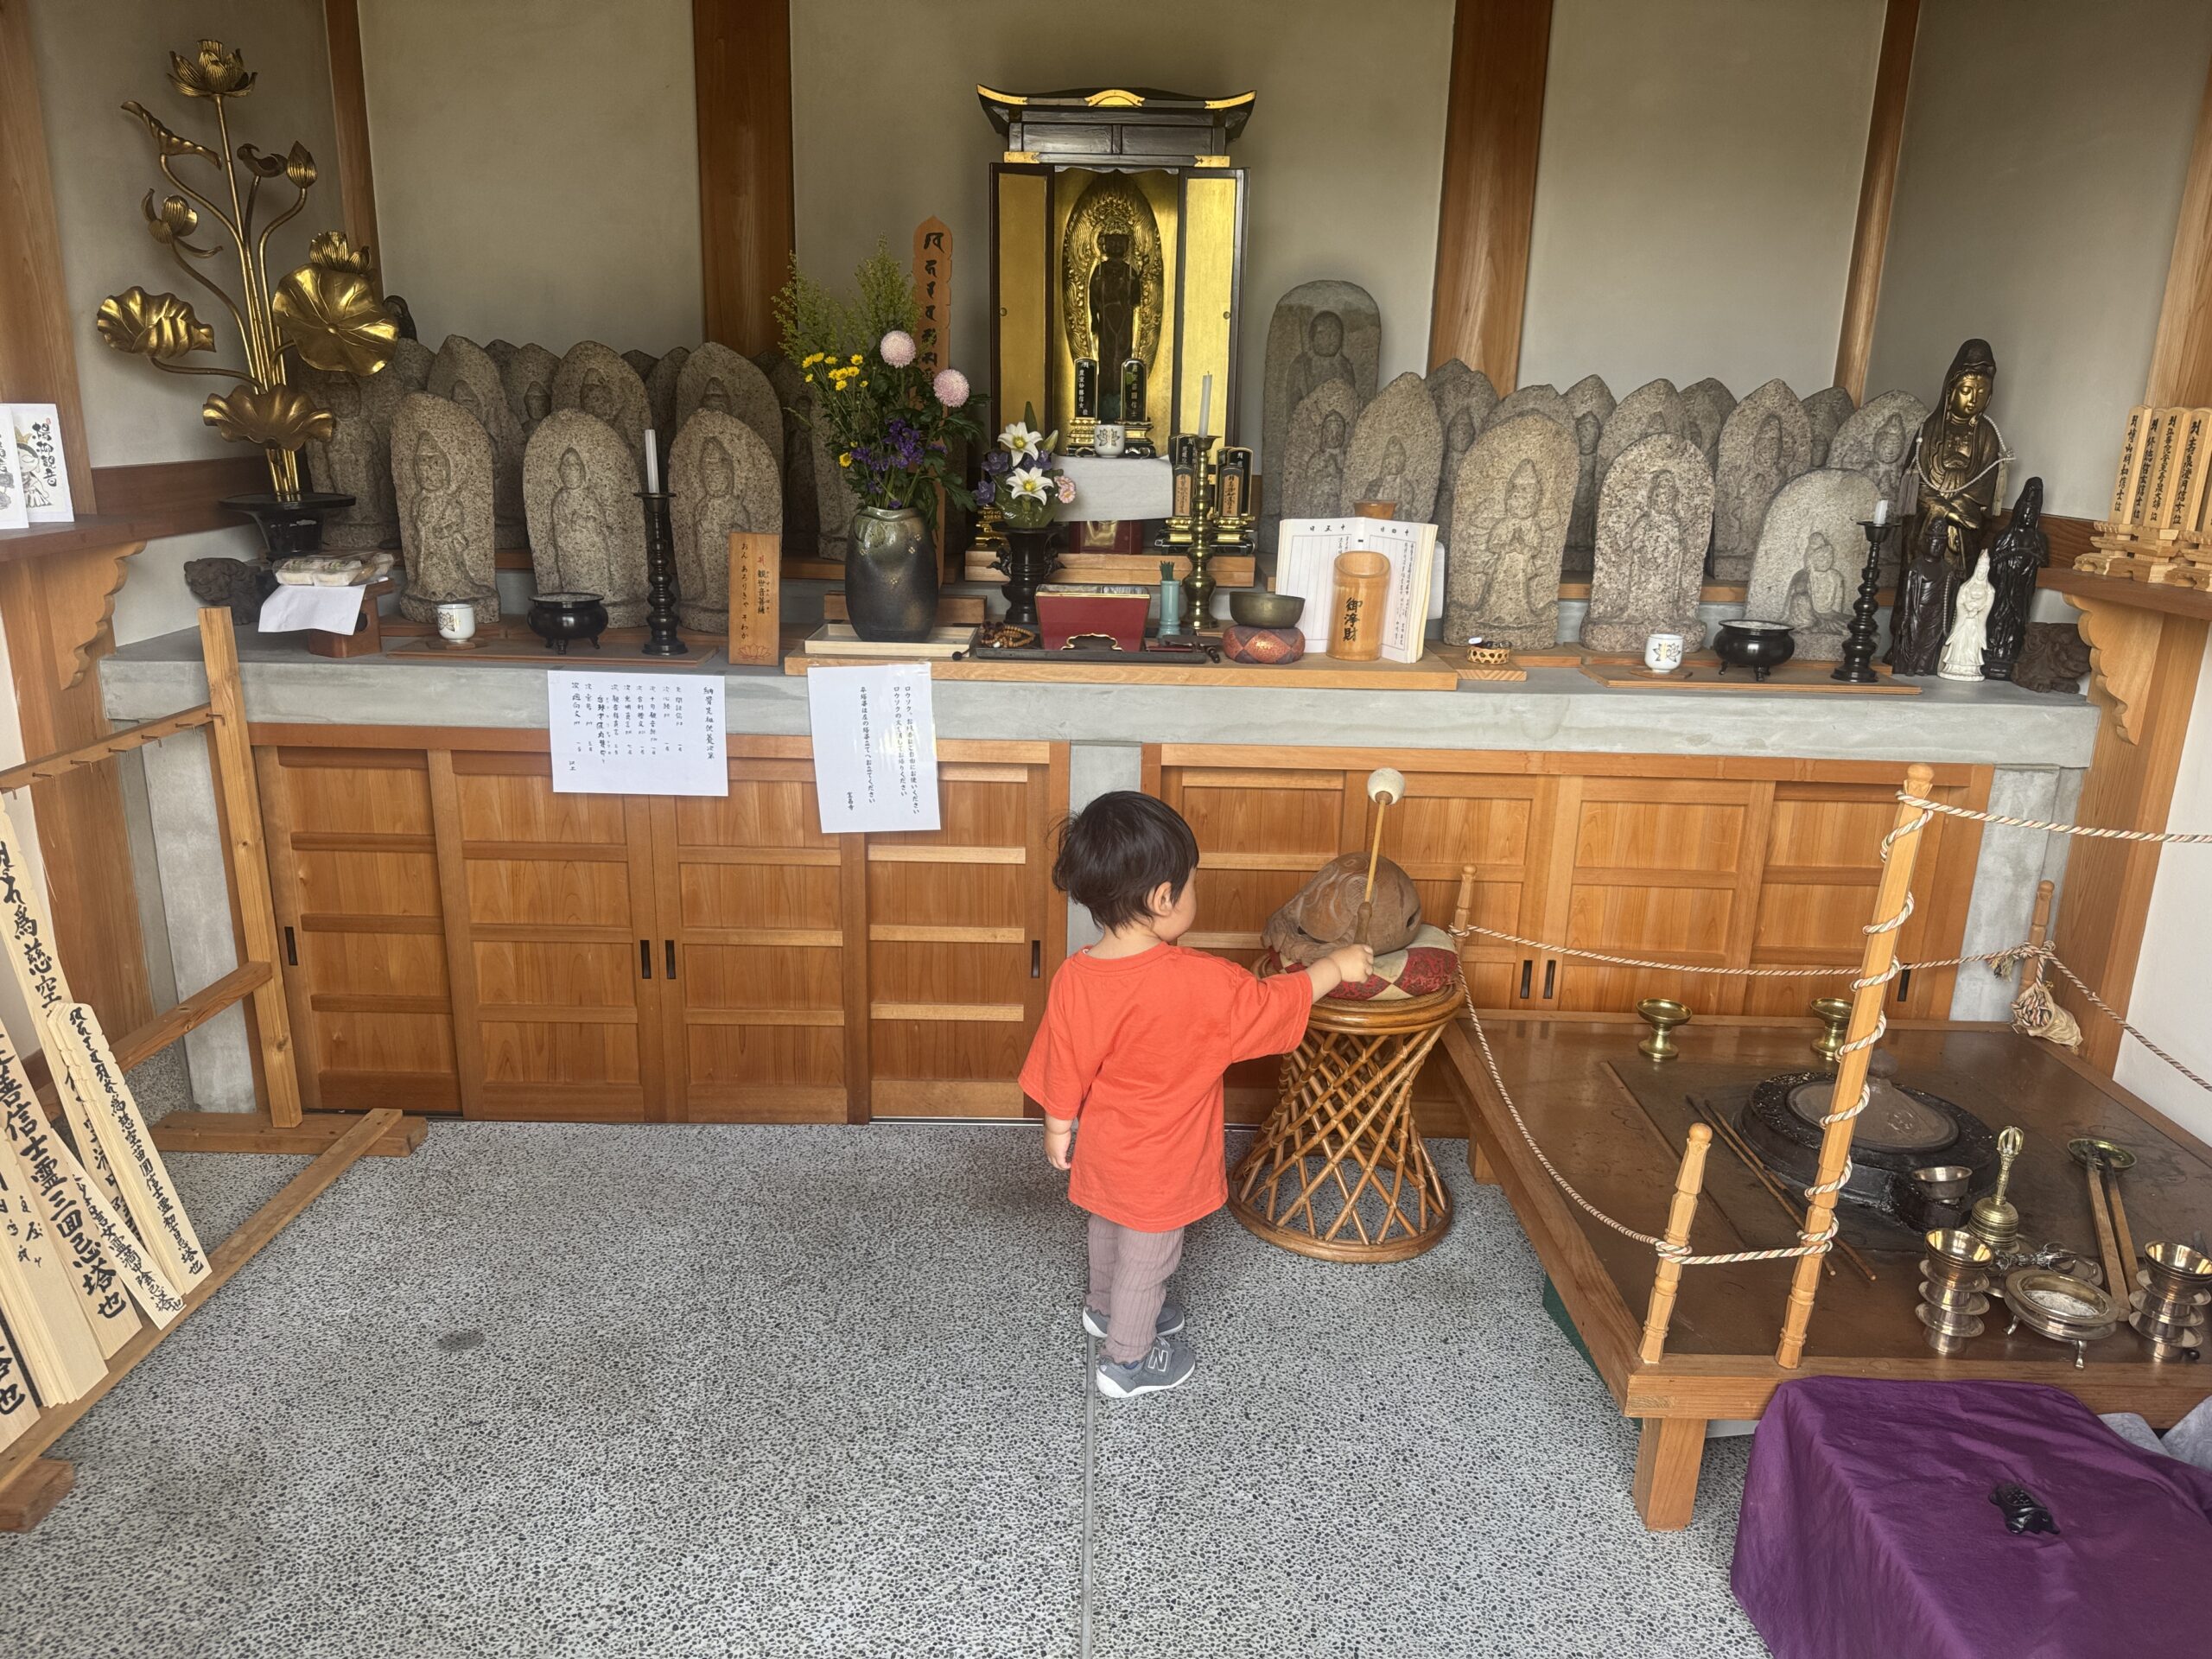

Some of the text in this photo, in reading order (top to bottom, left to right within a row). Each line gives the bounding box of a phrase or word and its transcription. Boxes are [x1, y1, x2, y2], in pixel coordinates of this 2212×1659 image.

[757, 569, 766, 614] 観世音菩薩
[1147, 1347, 1169, 1372] N
